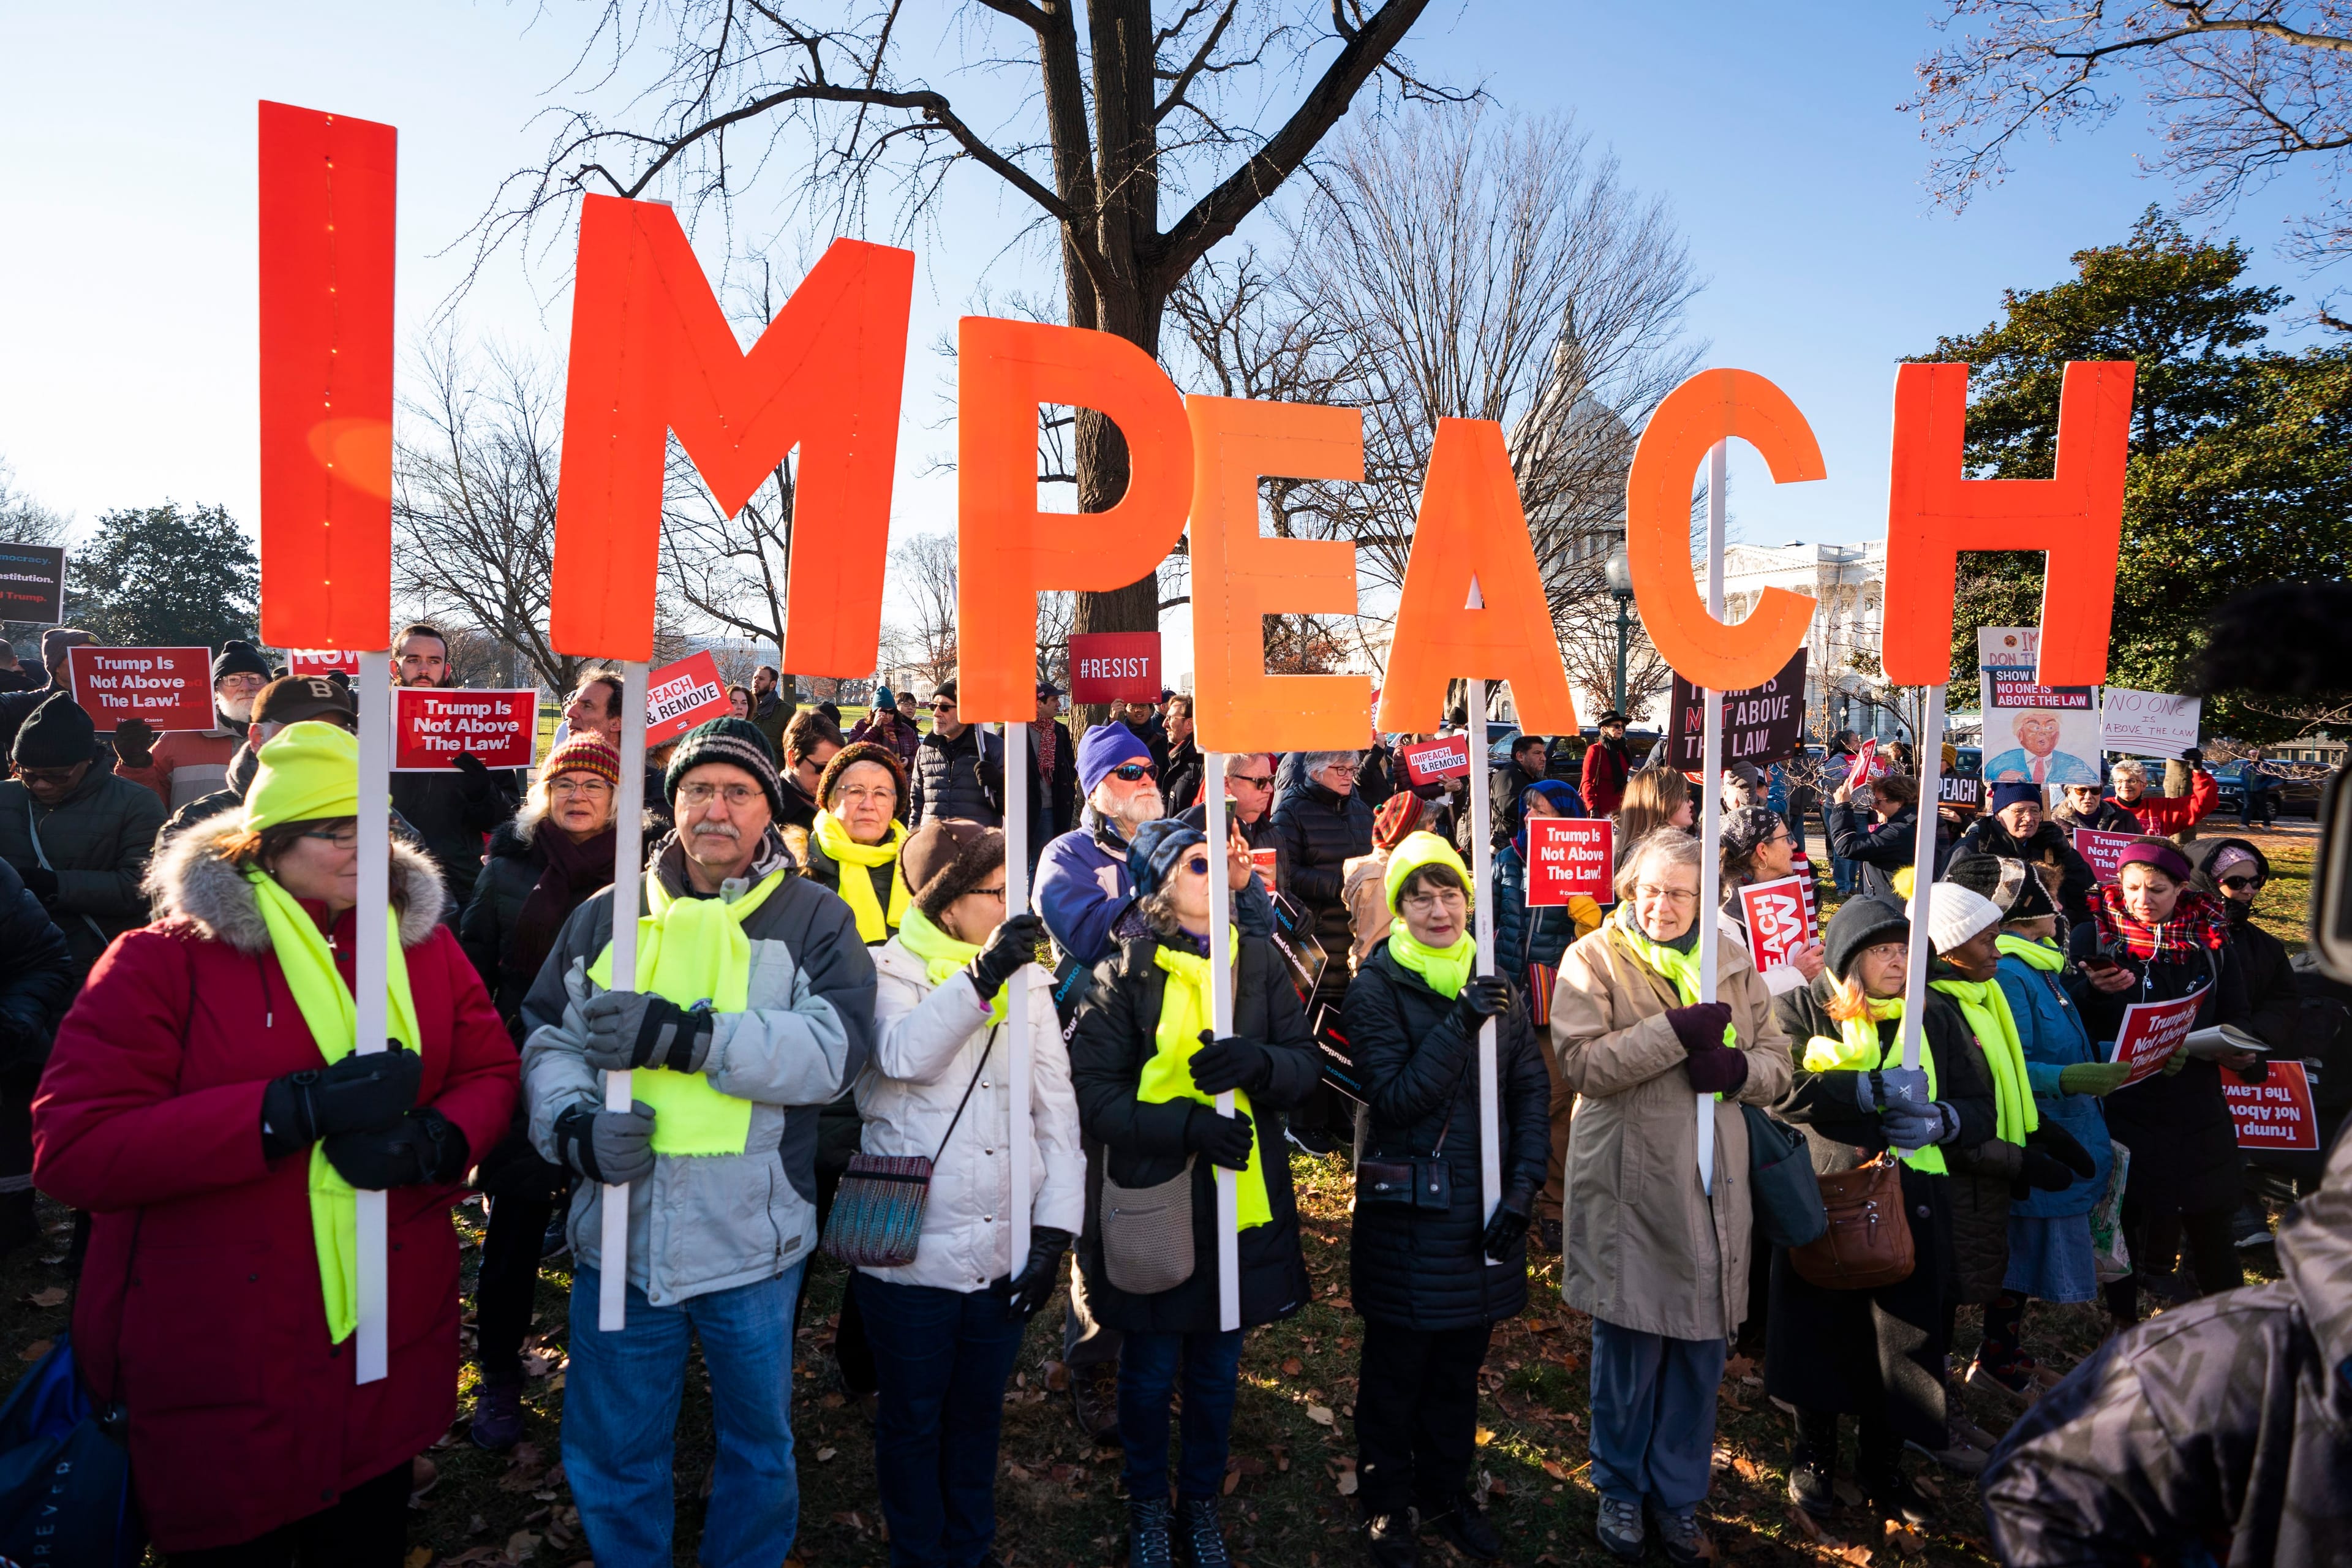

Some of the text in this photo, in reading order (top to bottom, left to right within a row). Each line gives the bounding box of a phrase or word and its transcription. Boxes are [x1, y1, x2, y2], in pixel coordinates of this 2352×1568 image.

[7, 591, 47, 603] Trump.
[94, 656, 175, 673] Trump Is
[1080, 657, 1149, 679] #RESIST
[89, 675, 118, 688] Not
[122, 675, 186, 688] Above
[1996, 671, 2029, 681] SHOW
[307, 680, 333, 698] B
[1997, 684, 2013, 693] NO
[2015, 684, 2038, 693] ONE
[99, 693, 180, 707] The Law!
[658, 685, 717, 719] REMOVE
[1998, 696, 2086, 706] ABOVE THE LAW
[2108, 695, 2186, 717] NO ONE
[424, 699, 512, 718] Trump Is
[1684, 703, 1734, 733] NT
[1735, 695, 1791, 726] ABOVE
[413, 718, 519, 733] Not Above
[2105, 723, 2195, 737] ABOVE THE LAW
[421, 735, 511, 751] The Law!
[1732, 728, 1770, 757] LAW.
[1411, 748, 1450, 764] IMPEACH
[1421, 755, 1465, 772] & REMOVE
[1547, 827, 1600, 845] Trump Is
[2092, 835, 2130, 848] Trump
[1541, 846, 1604, 861] Not Above
[2087, 846, 2108, 856] Not
[2094, 858, 2116, 869] The
[1547, 865, 1601, 880] The Law!
[1275, 907, 1293, 932] Protect
[2148, 1003, 2196, 1033] Trump Is
[1063, 1016, 1078, 1041] Our
[2131, 1022, 2191, 1055] Not Above
[1318, 1041, 1354, 1067] stitution.
[2132, 1054, 2149, 1069] The
[2265, 1087, 2291, 1101] The
[2275, 1107, 2301, 1121] Not
[2243, 1121, 2296, 1140] Trump
